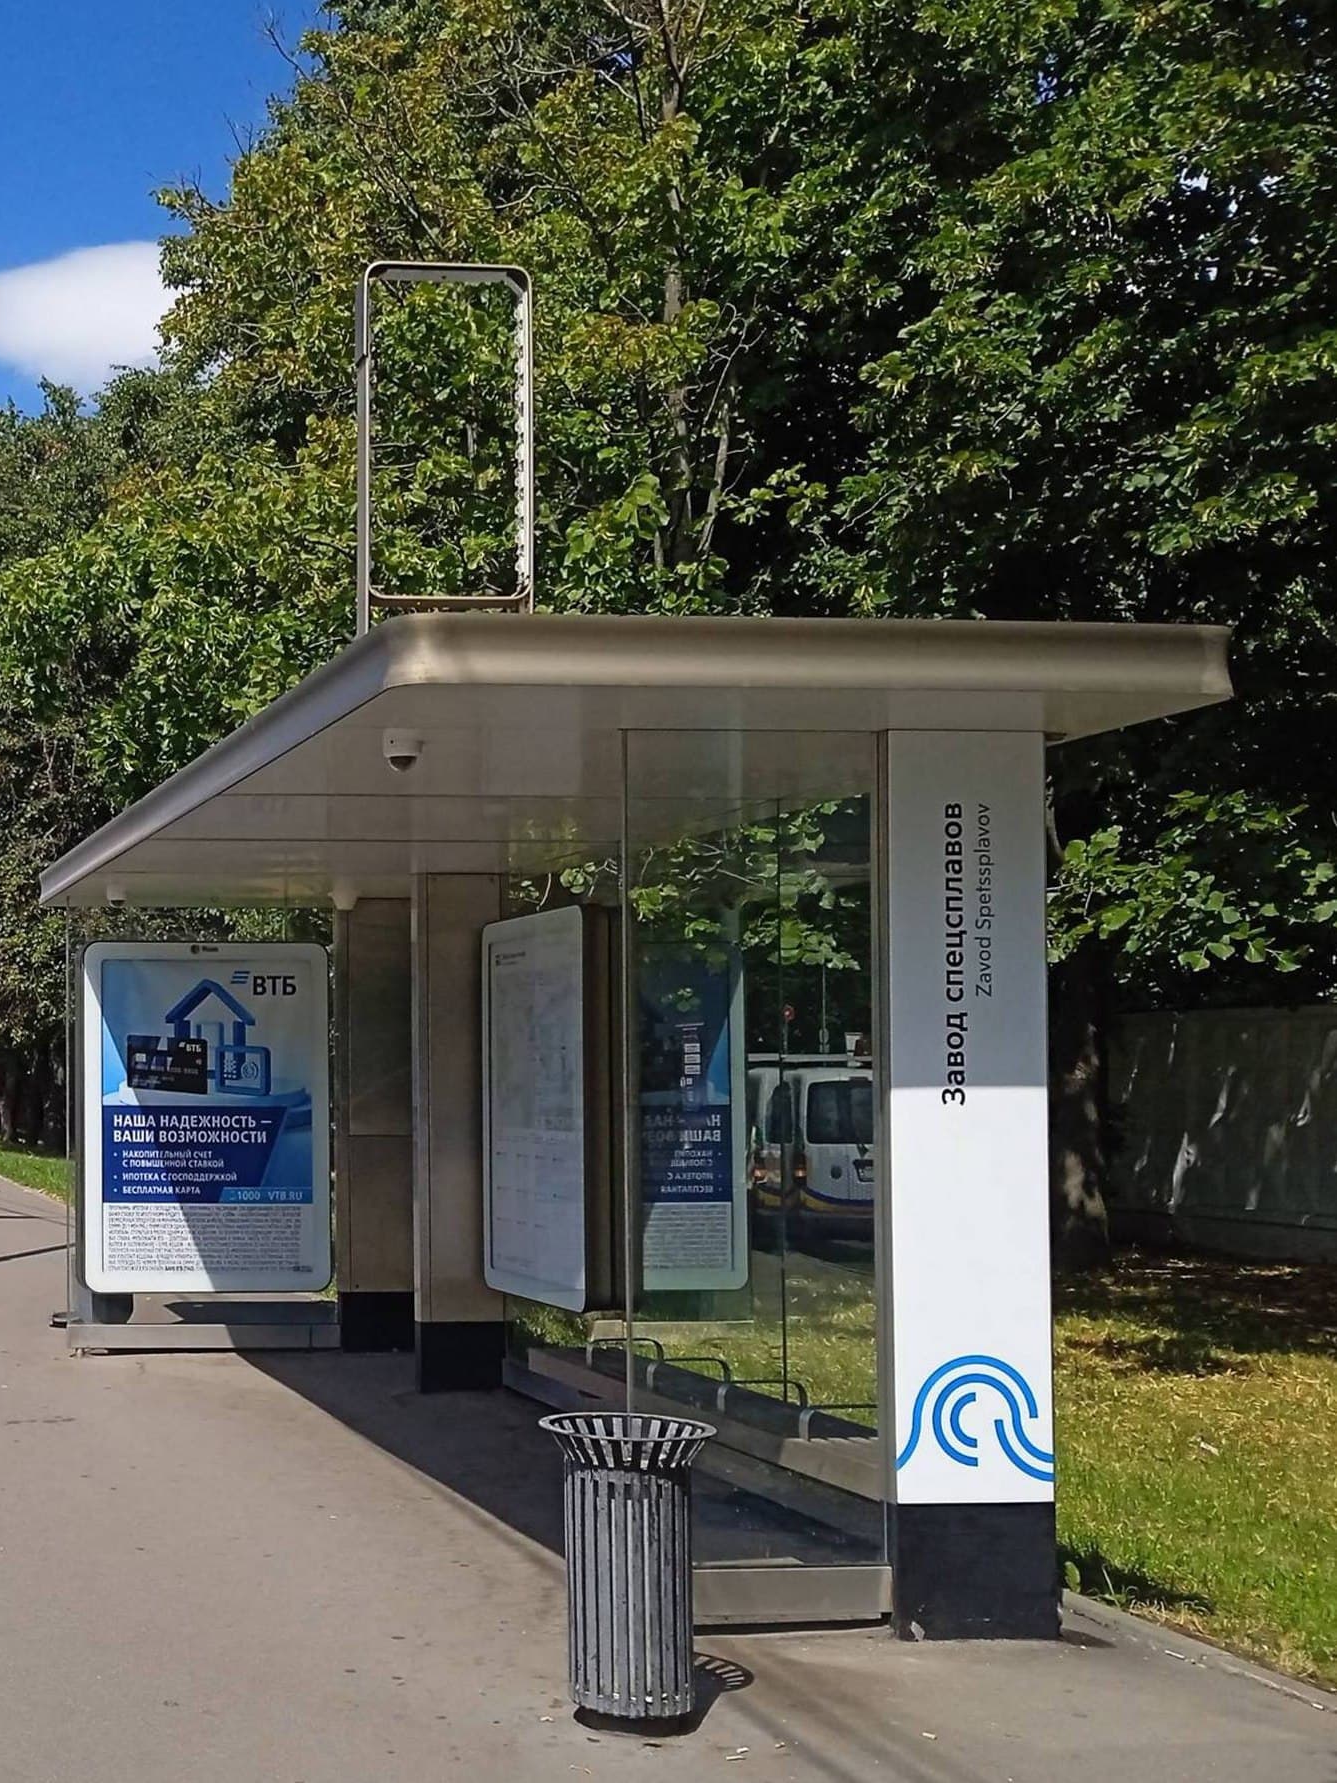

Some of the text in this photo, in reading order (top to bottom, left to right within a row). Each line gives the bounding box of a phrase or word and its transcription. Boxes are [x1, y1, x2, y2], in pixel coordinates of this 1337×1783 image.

[973, 803, 995, 997] Zavod Spetssplavov
[942, 802, 968, 1106] Завод спецсплавов
[253, 976, 297, 996] ВТБ
[113, 1114, 156, 1128] НАША
[160, 1115, 256, 1129] НАДЕЖНОСТЬ
[113, 1130, 267, 1143] ВАШИ ВОЗМОЖНОСТИ
[122, 1149, 213, 1159] НАКОПИТЕЛЬНЫЙ СЧЕТ
[122, 1158, 224, 1168] С ПОВЫШЕННОЙ СТАВКОЙ
[122, 1172, 237, 1182] ИПОТЕКА С ГОСПОДДЕРЖКОЙ
[123, 1185, 201, 1194] БЕСПЛАТНАЯ КАРТА
[237, 1191, 303, 1200] 1000 VTB.RU
